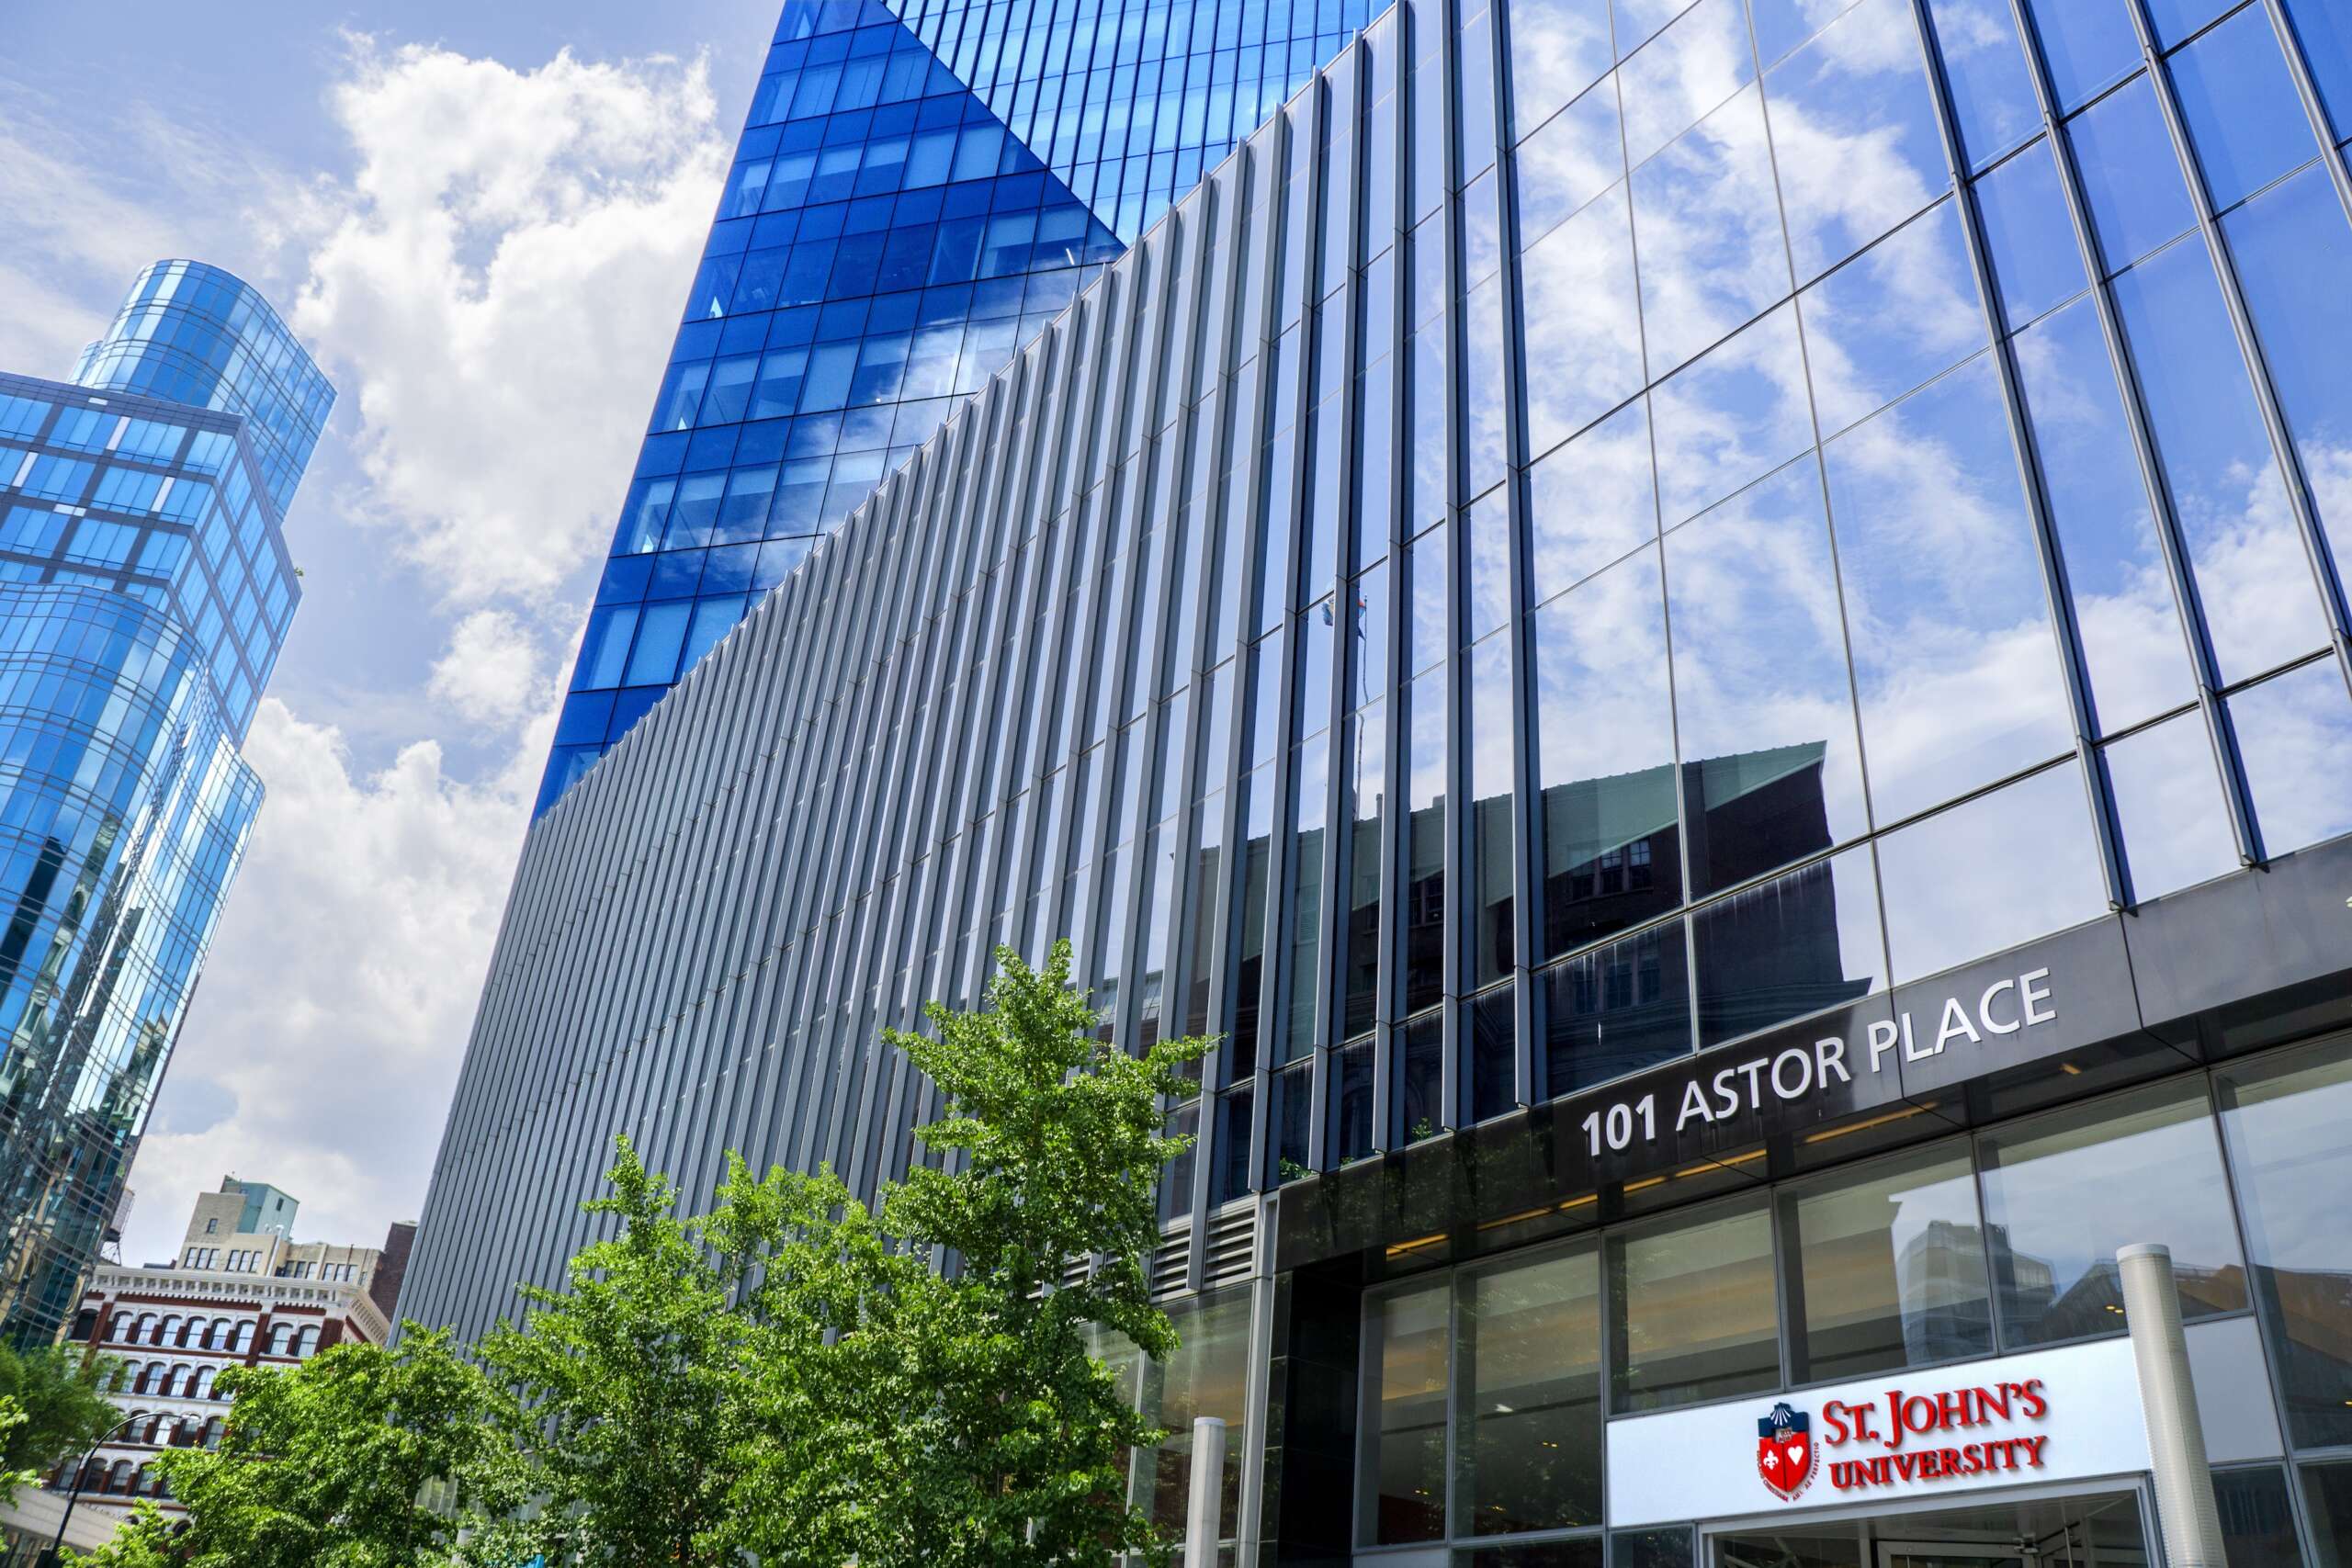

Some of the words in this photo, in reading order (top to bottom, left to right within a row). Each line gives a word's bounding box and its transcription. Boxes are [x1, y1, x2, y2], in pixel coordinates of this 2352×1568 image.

[1581, 1093, 1655, 1156] 101
[1675, 1036, 1851, 1132] ASTOR
[1868, 966, 2057, 1073] PLACE
[1822, 1400, 1879, 1446] ST.
[1883, 1378, 2047, 1449] JOHN'S
[1828, 1435, 2047, 1490] UNIVERSITY
